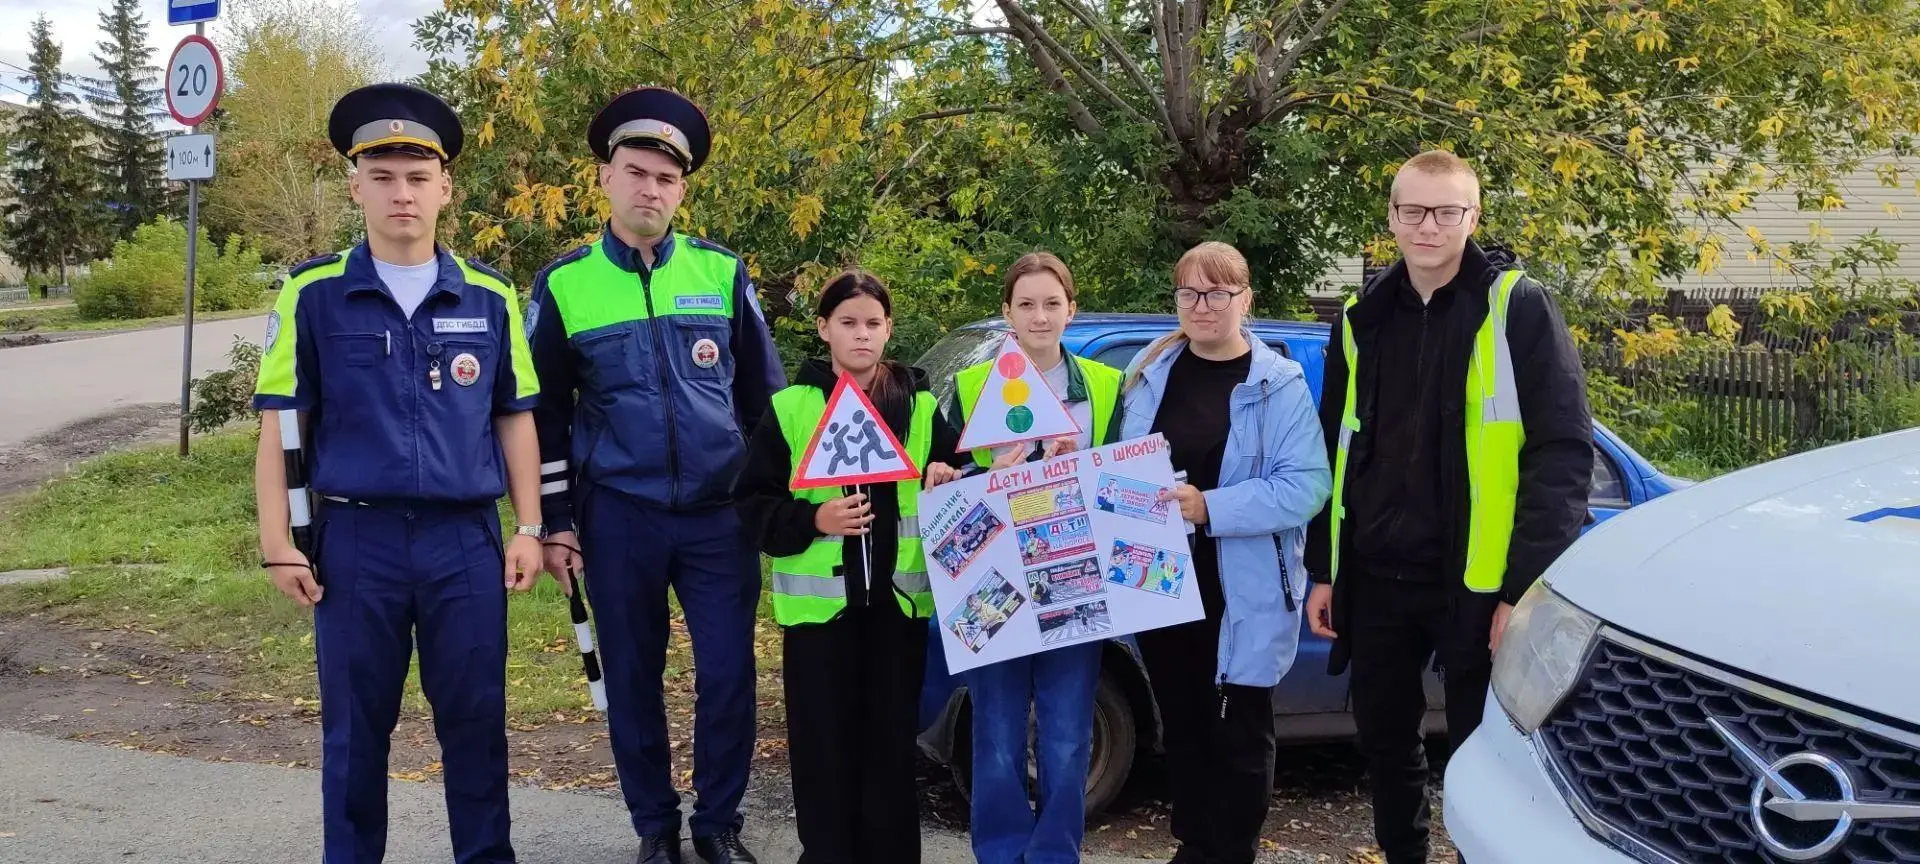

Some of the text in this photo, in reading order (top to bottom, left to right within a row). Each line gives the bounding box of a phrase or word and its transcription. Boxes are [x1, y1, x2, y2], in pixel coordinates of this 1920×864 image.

[177, 64, 207, 96] 20
[437, 321, 486, 330] ДПС ГИБДД
[986, 470, 1032, 494] Дети
[1051, 517, 1087, 535] ДЕТИ
